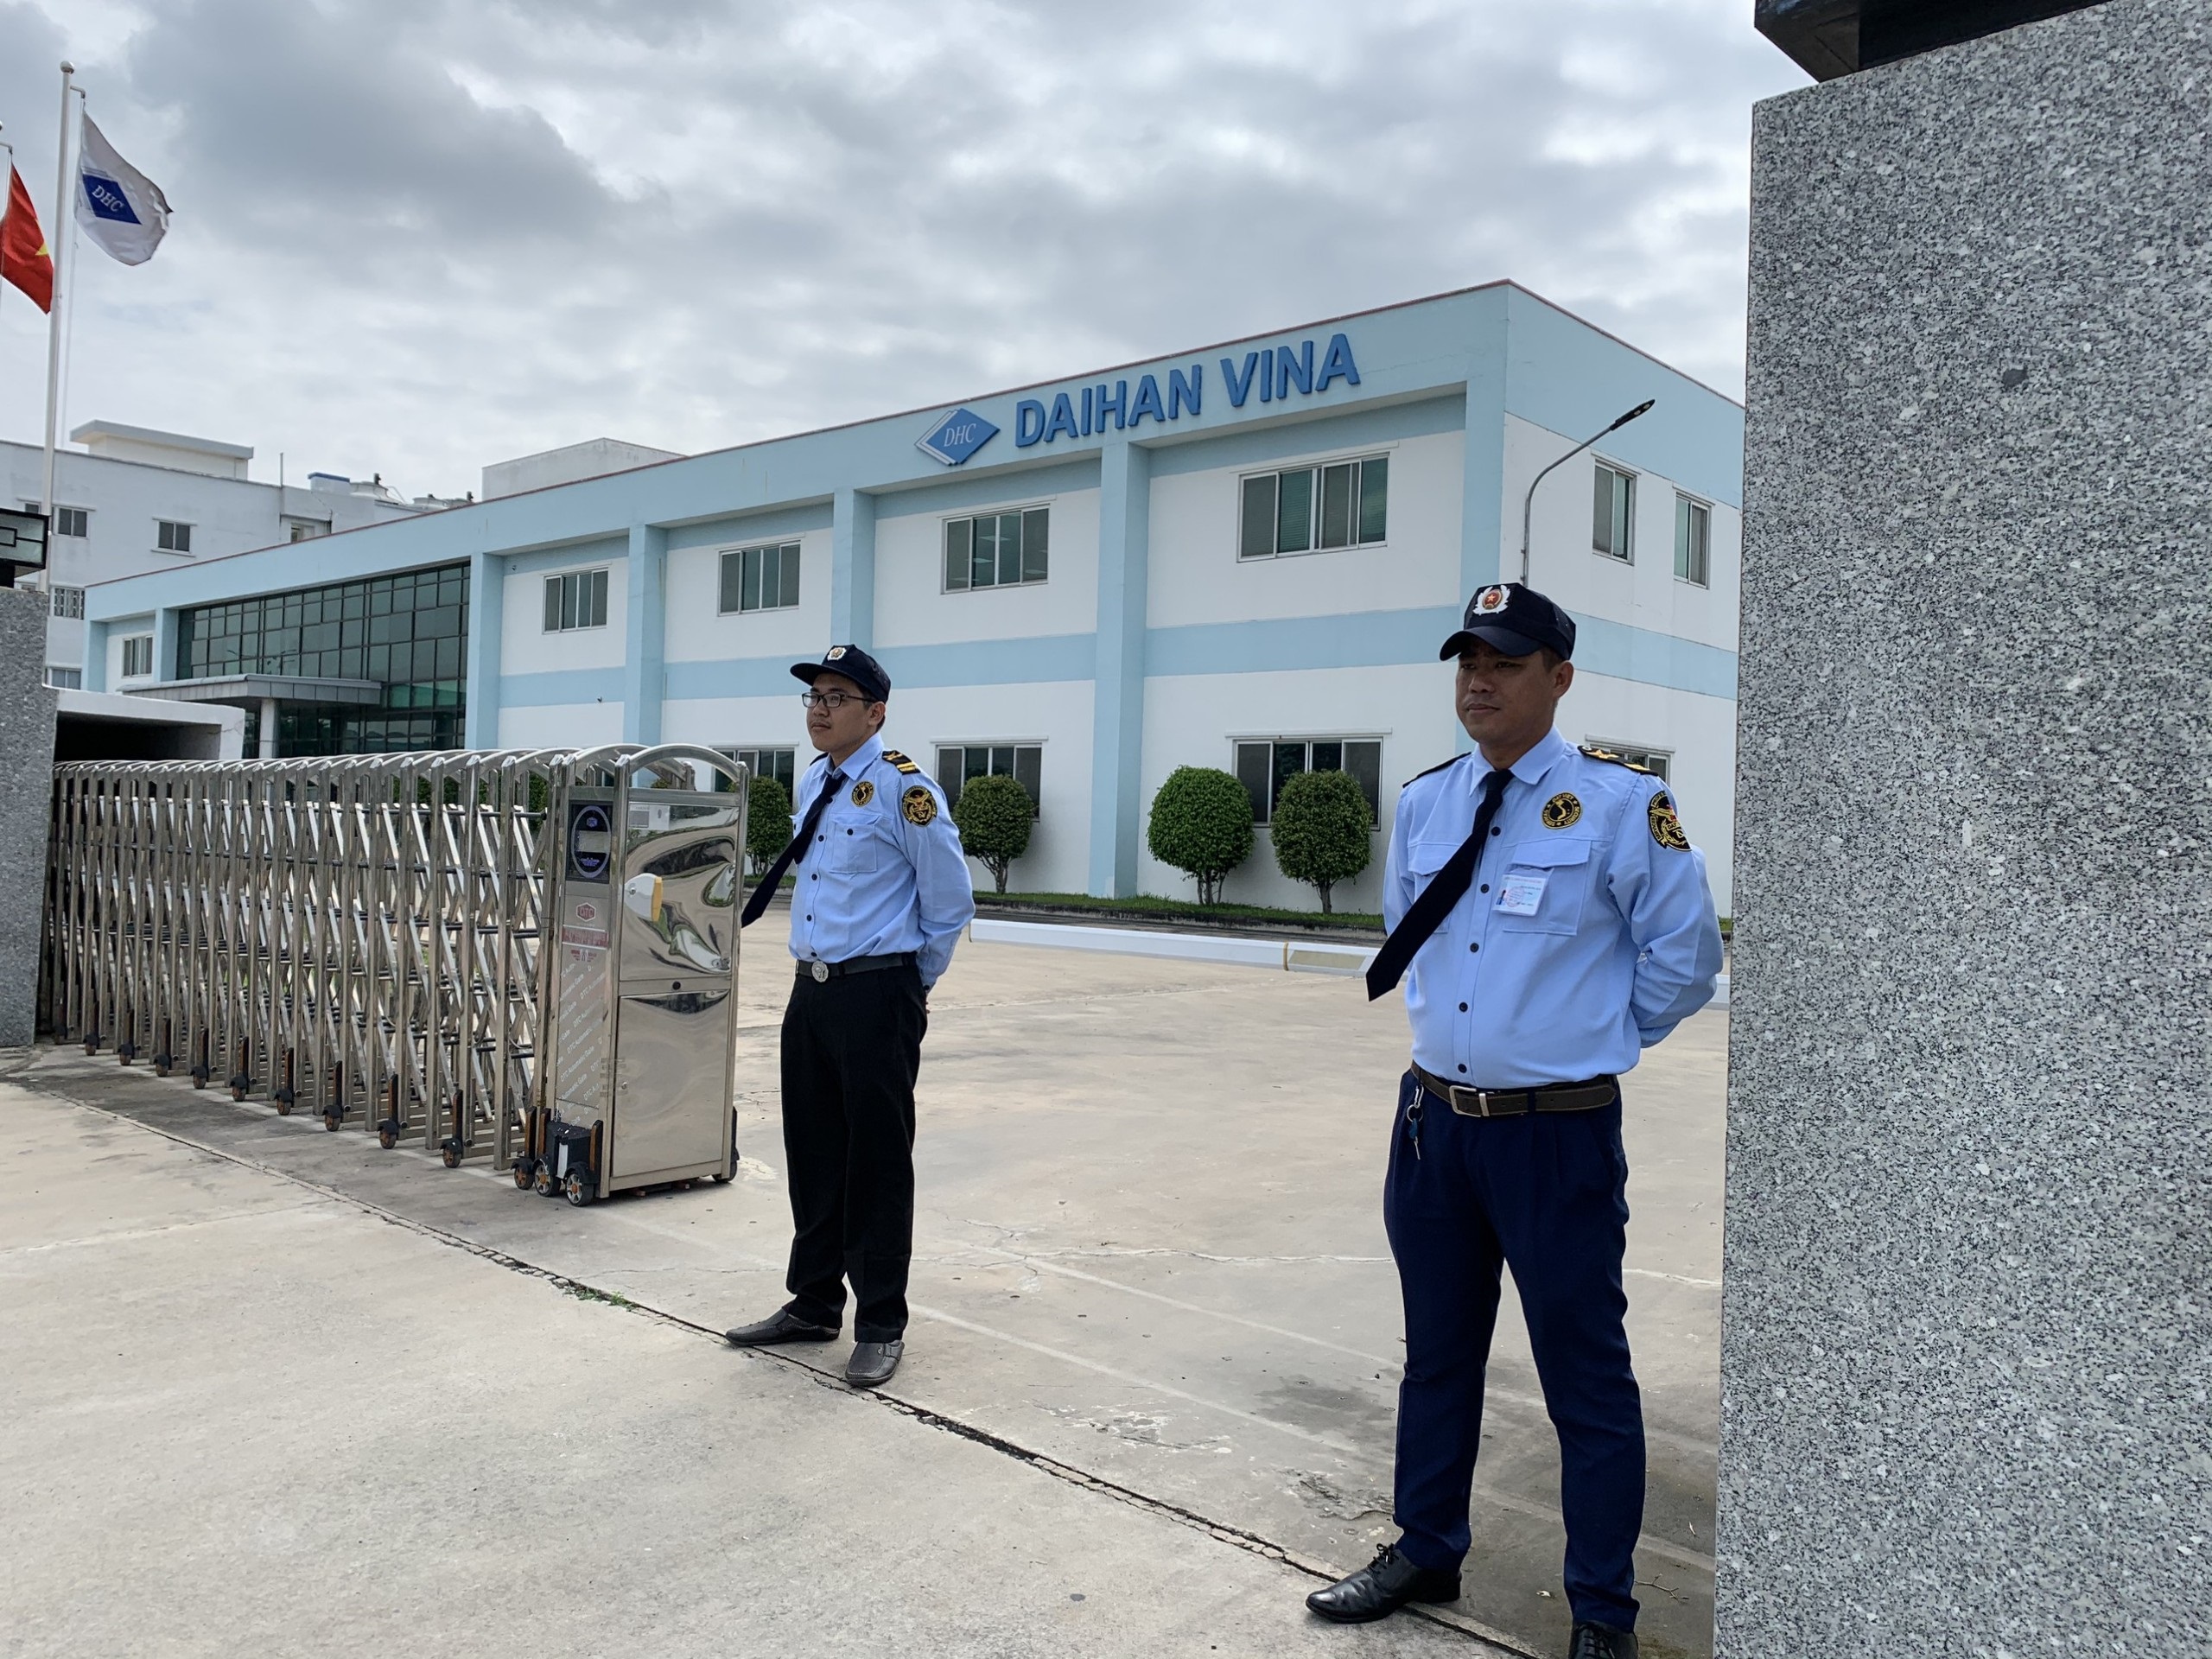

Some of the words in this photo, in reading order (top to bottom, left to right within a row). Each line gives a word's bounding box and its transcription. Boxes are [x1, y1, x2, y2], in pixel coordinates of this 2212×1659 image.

[92, 184, 124, 213] DHC
[1014, 363, 1203, 448] DAIHAN
[1219, 333, 1361, 408] VINA
[943, 422, 976, 448] DHC
[1564, 805, 1580, 825] SECURITY
